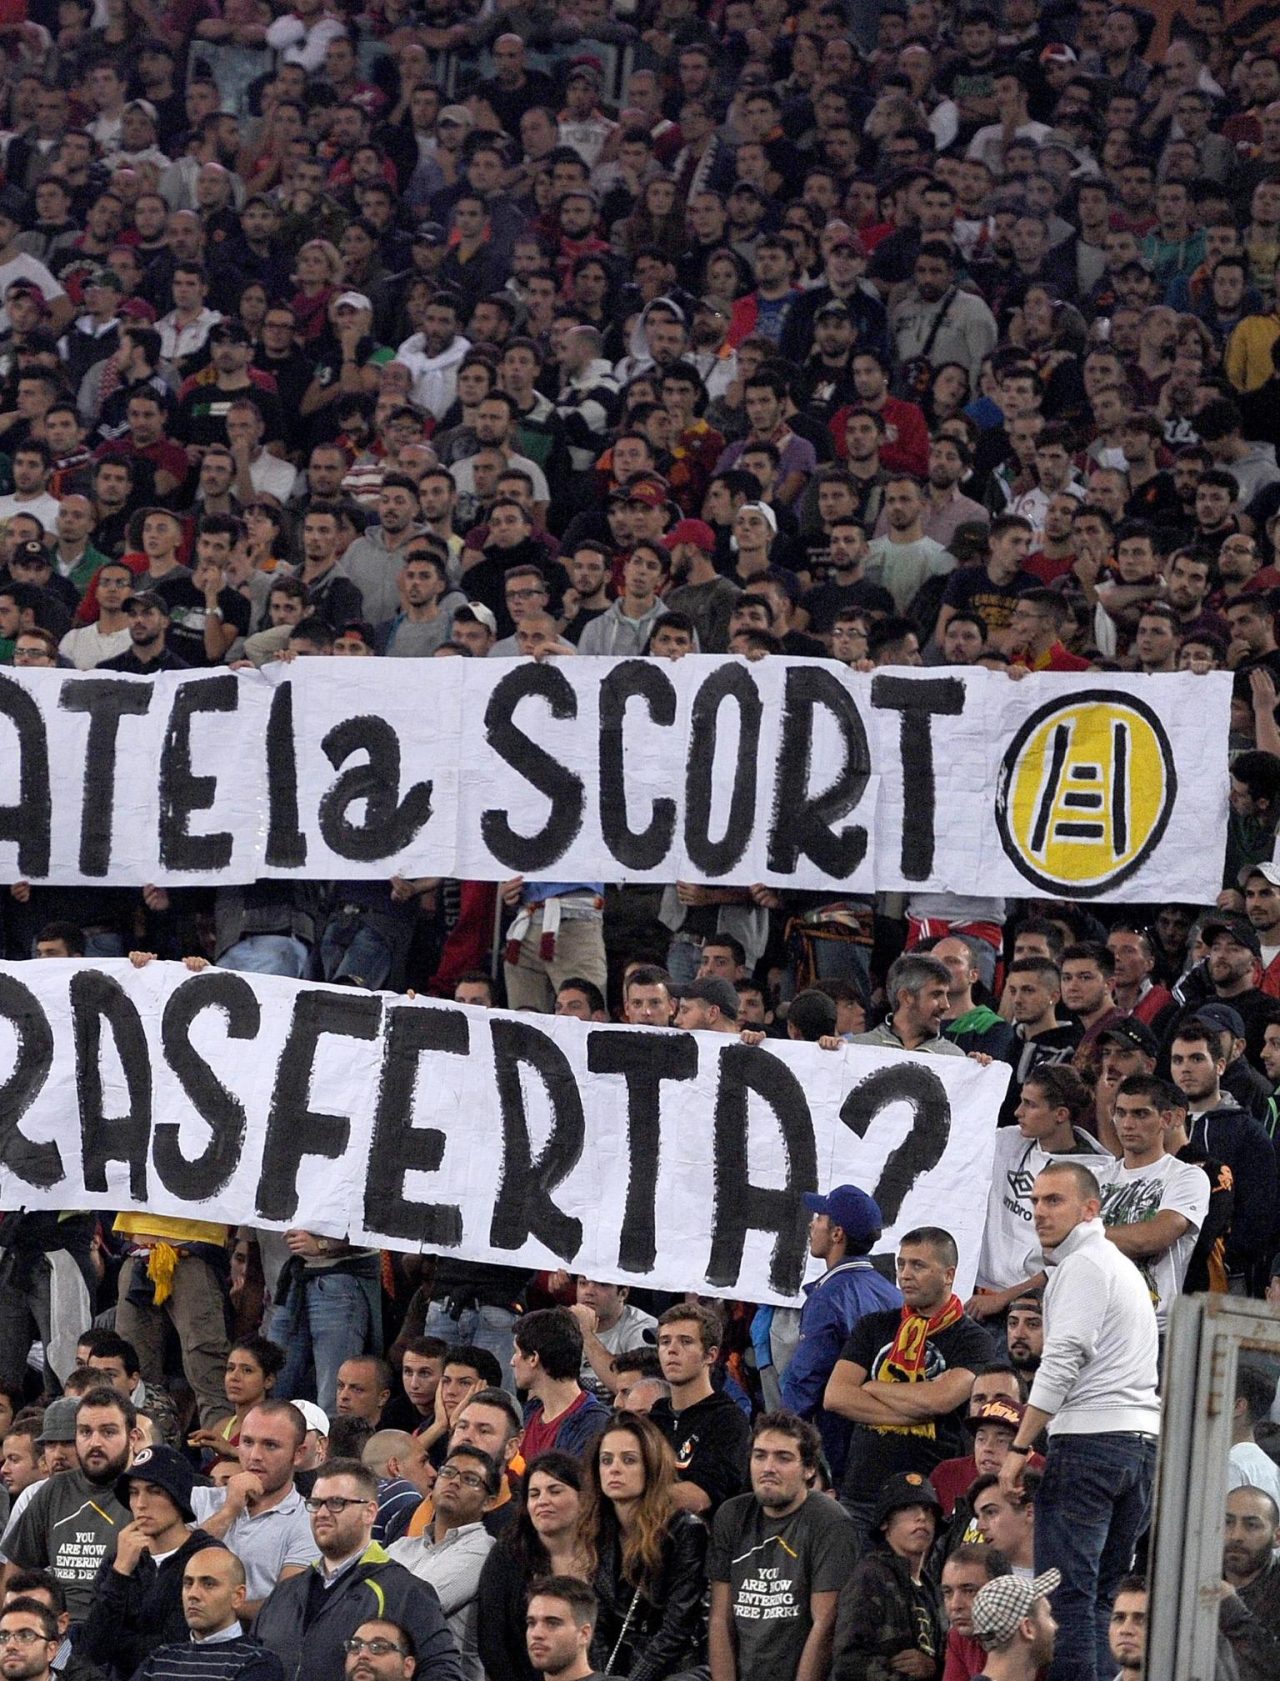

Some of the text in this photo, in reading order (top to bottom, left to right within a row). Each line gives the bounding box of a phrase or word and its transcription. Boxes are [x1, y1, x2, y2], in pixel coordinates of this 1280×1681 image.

[265, 680, 433, 868] la
[75, 1531, 95, 1543] YOU
[58, 1543, 107, 1556] ARE NOW
[56, 1555, 103, 1568] ENTERIN
[78, 1569, 97, 1580] DE
[758, 1567, 780, 1580] YOU
[741, 1579, 768, 1593] ARE
